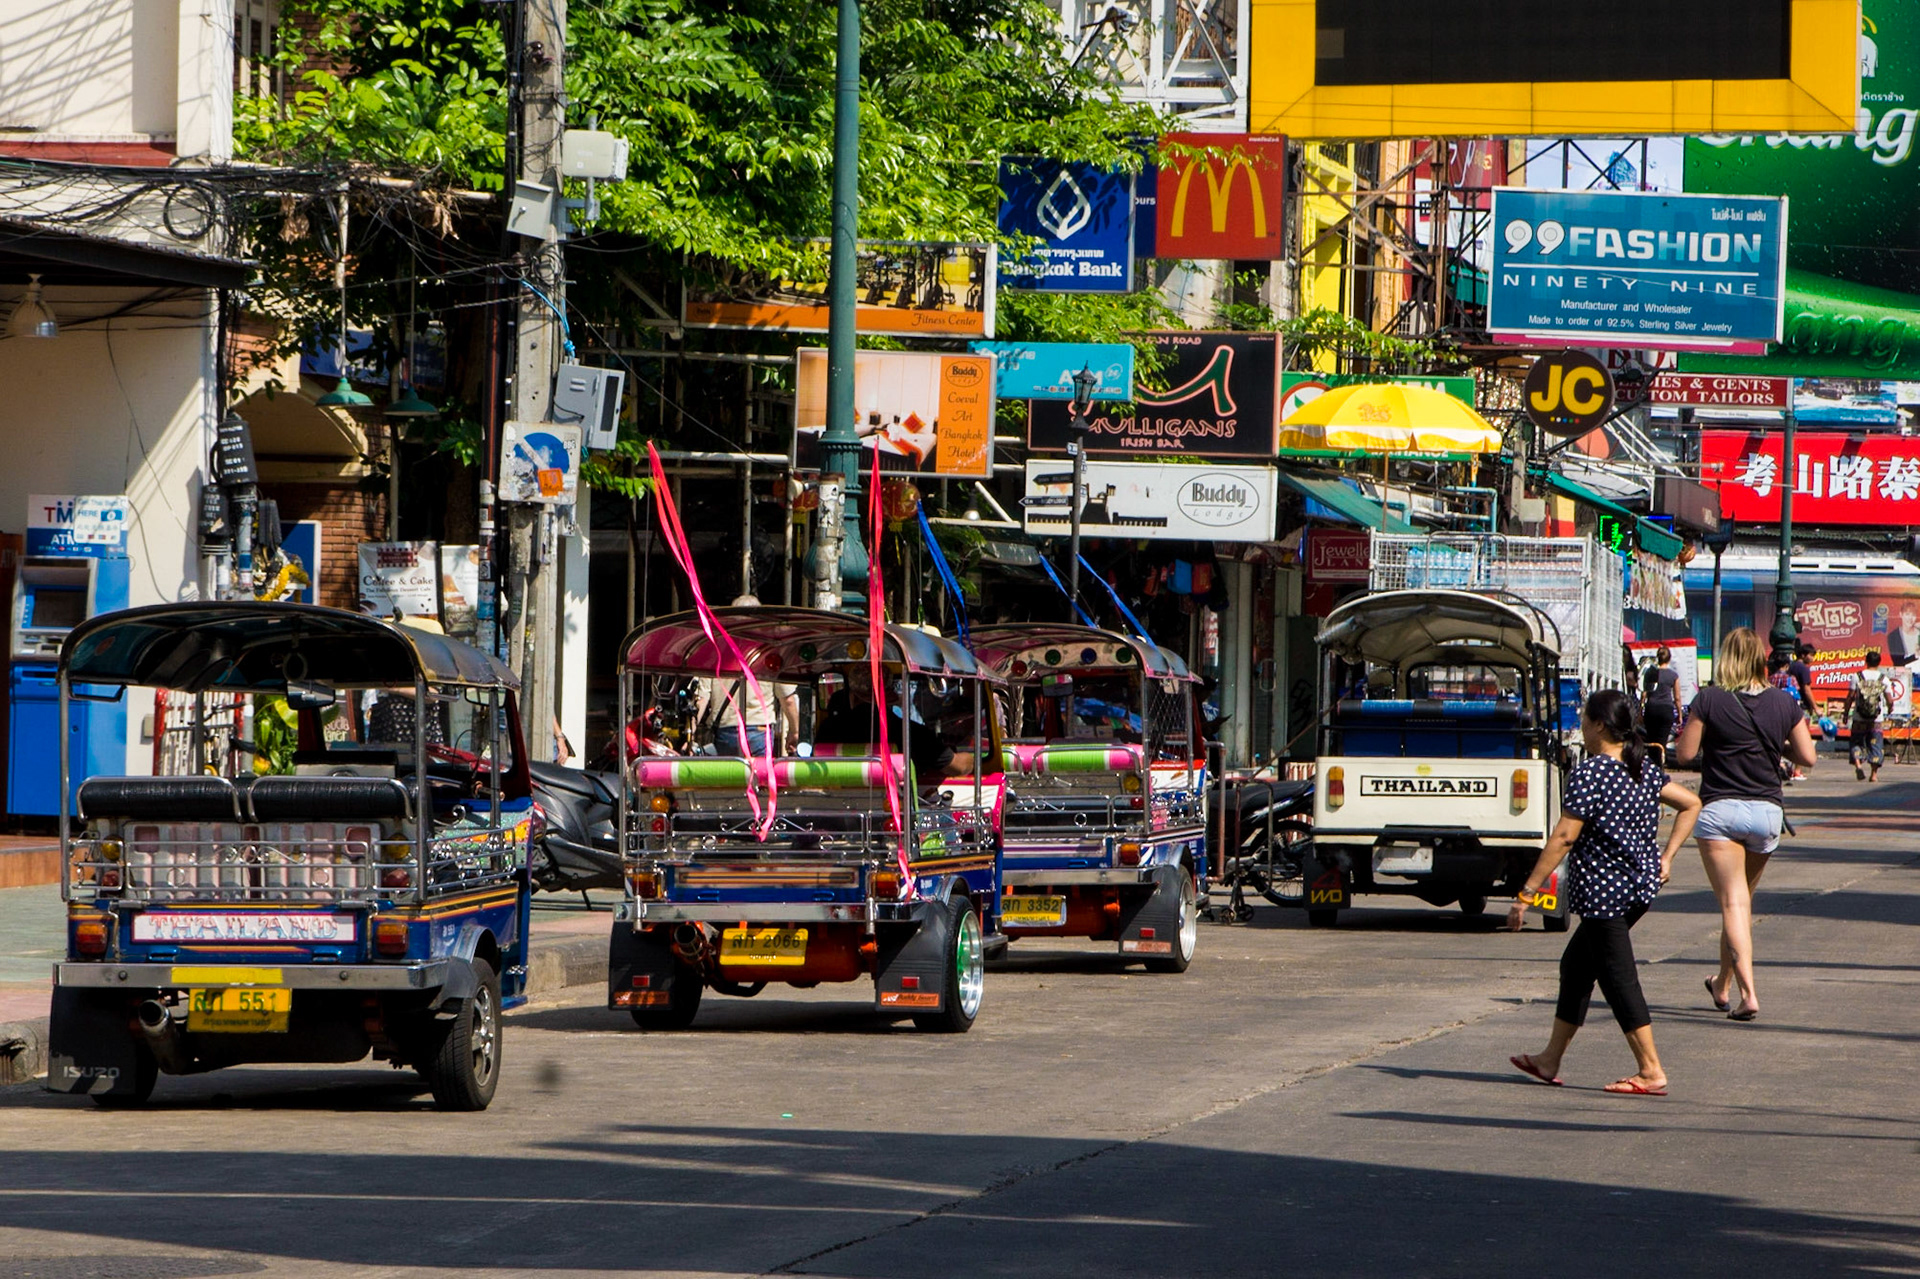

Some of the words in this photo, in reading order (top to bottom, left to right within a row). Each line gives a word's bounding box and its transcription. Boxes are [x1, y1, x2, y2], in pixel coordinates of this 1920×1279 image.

[1861, 91, 1904, 102] ติตราช้าง
[1002, 261, 1075, 279] Bangkok
[1078, 261, 1123, 277] Bank
[1503, 274, 1639, 291] NINETY
[1670, 280, 1758, 296] NINE
[1560, 299, 1618, 311] Manufacturer
[1622, 302, 1640, 312] and
[1644, 303, 1693, 315] Wholesaler
[911, 313, 946, 327] Fitness
[948, 314, 977, 326] Center
[1528, 315, 1551, 325] Made
[1555, 316, 1564, 325] to
[1568, 316, 1589, 326] order
[1594, 317, 1603, 327] of
[1606, 317, 1635, 328] 92.5%
[1639, 319, 1671, 332] Sterling
[1674, 320, 1697, 331] Silver
[1701, 322, 1733, 334] Jewelry
[1172, 336, 1202, 345] ROAD
[952, 365, 978, 377] Buddy
[1530, 364, 1605, 417] JC
[1690, 377, 1704, 390] &
[1712, 377, 1771, 391] GENTS
[947, 391, 979, 405] Coeval
[1616, 388, 1689, 402] CUTOM
[1699, 391, 1775, 405] TAILORS
[952, 410, 973, 422] Art
[941, 427, 983, 443] Bangkok
[1120, 437, 1153, 447] IRISH
[1156, 438, 1185, 449] BAR
[948, 445, 976, 458] Hotel
[1191, 482, 1247, 505] Buddy
[44, 501, 74, 523] TM
[1192, 508, 1244, 521] Lodge
[1314, 541, 1370, 567] Jewelle
[1326, 558, 1364, 567] LAN
[398, 576, 407, 586] &
[410, 575, 433, 586] Cake
[1370, 780, 1489, 793] THAILAND
[1027, 898, 1060, 912] 3352
[149, 915, 339, 939] THAILAND
[762, 934, 801, 949] 2066
[239, 991, 277, 1013] 551
